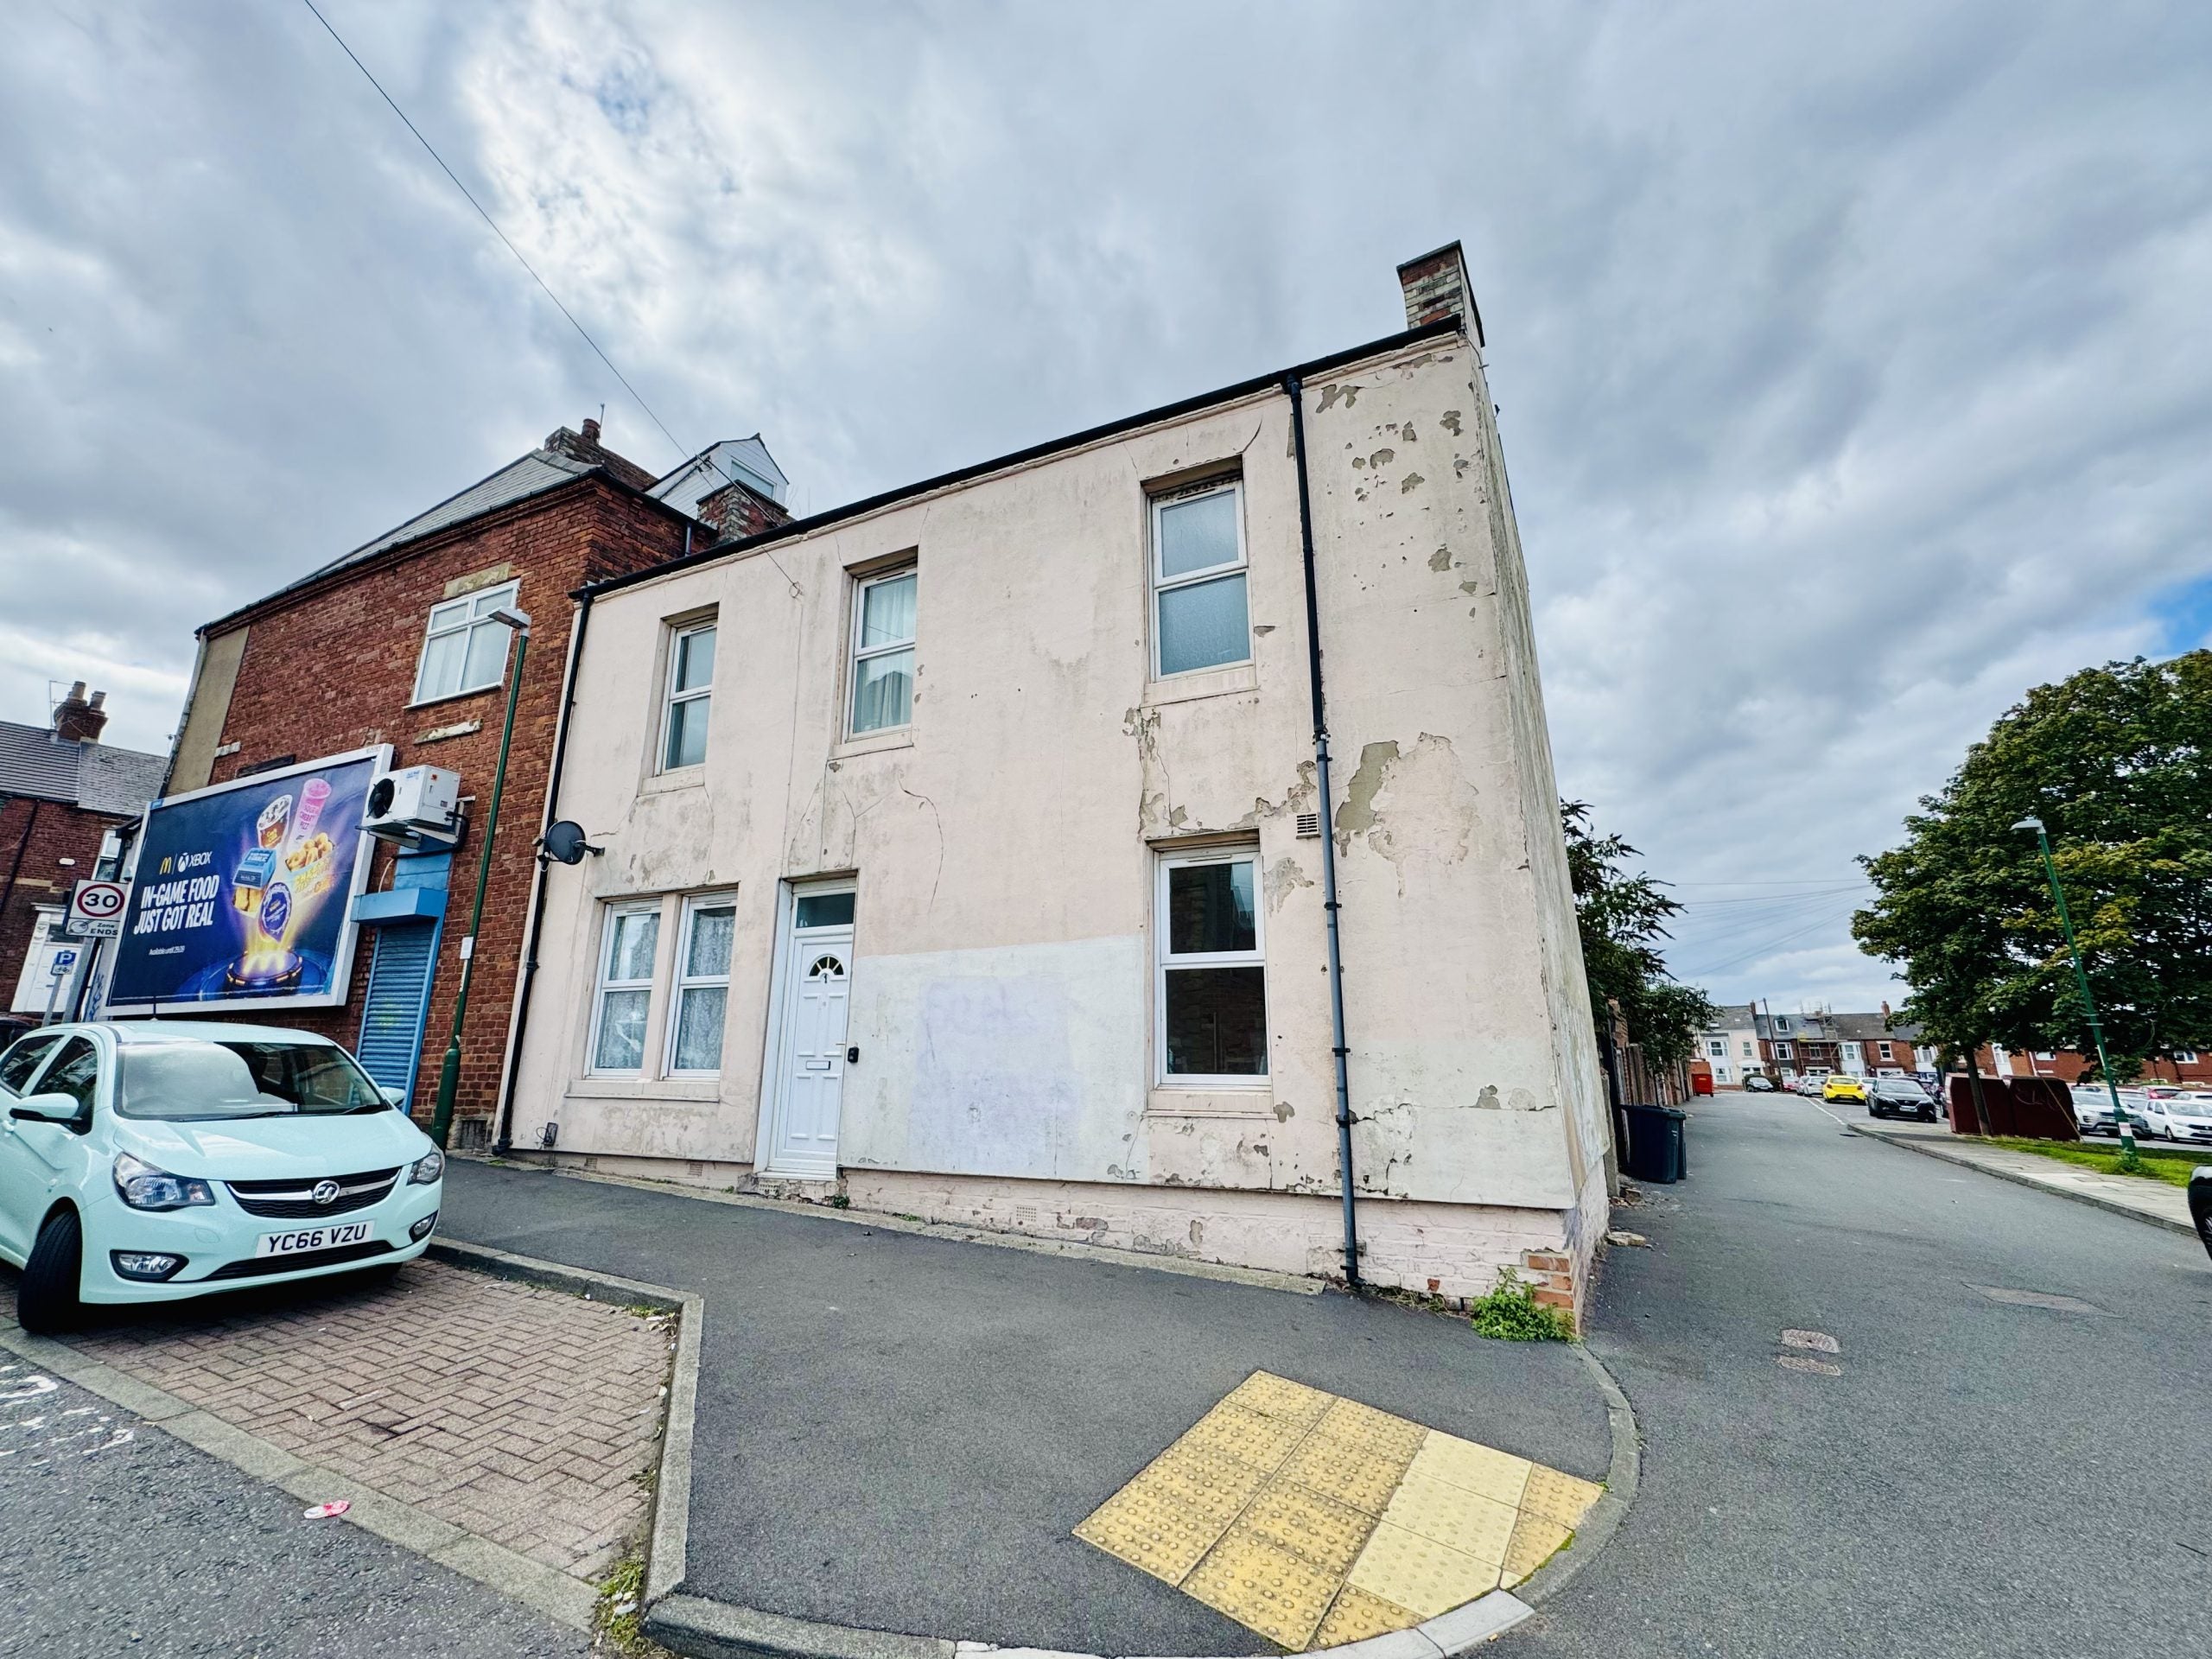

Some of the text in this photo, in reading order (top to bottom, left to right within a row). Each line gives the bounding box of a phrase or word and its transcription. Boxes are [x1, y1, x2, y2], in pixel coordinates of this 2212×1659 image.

[188, 851, 213, 868] XBOX
[84, 893, 118, 908] 30
[140, 874, 220, 909] IN-GAME FOOD
[133, 900, 215, 935] JUST GOT REAL
[60, 953, 73, 965] P
[269, 1224, 367, 1253] YC66 VZU
